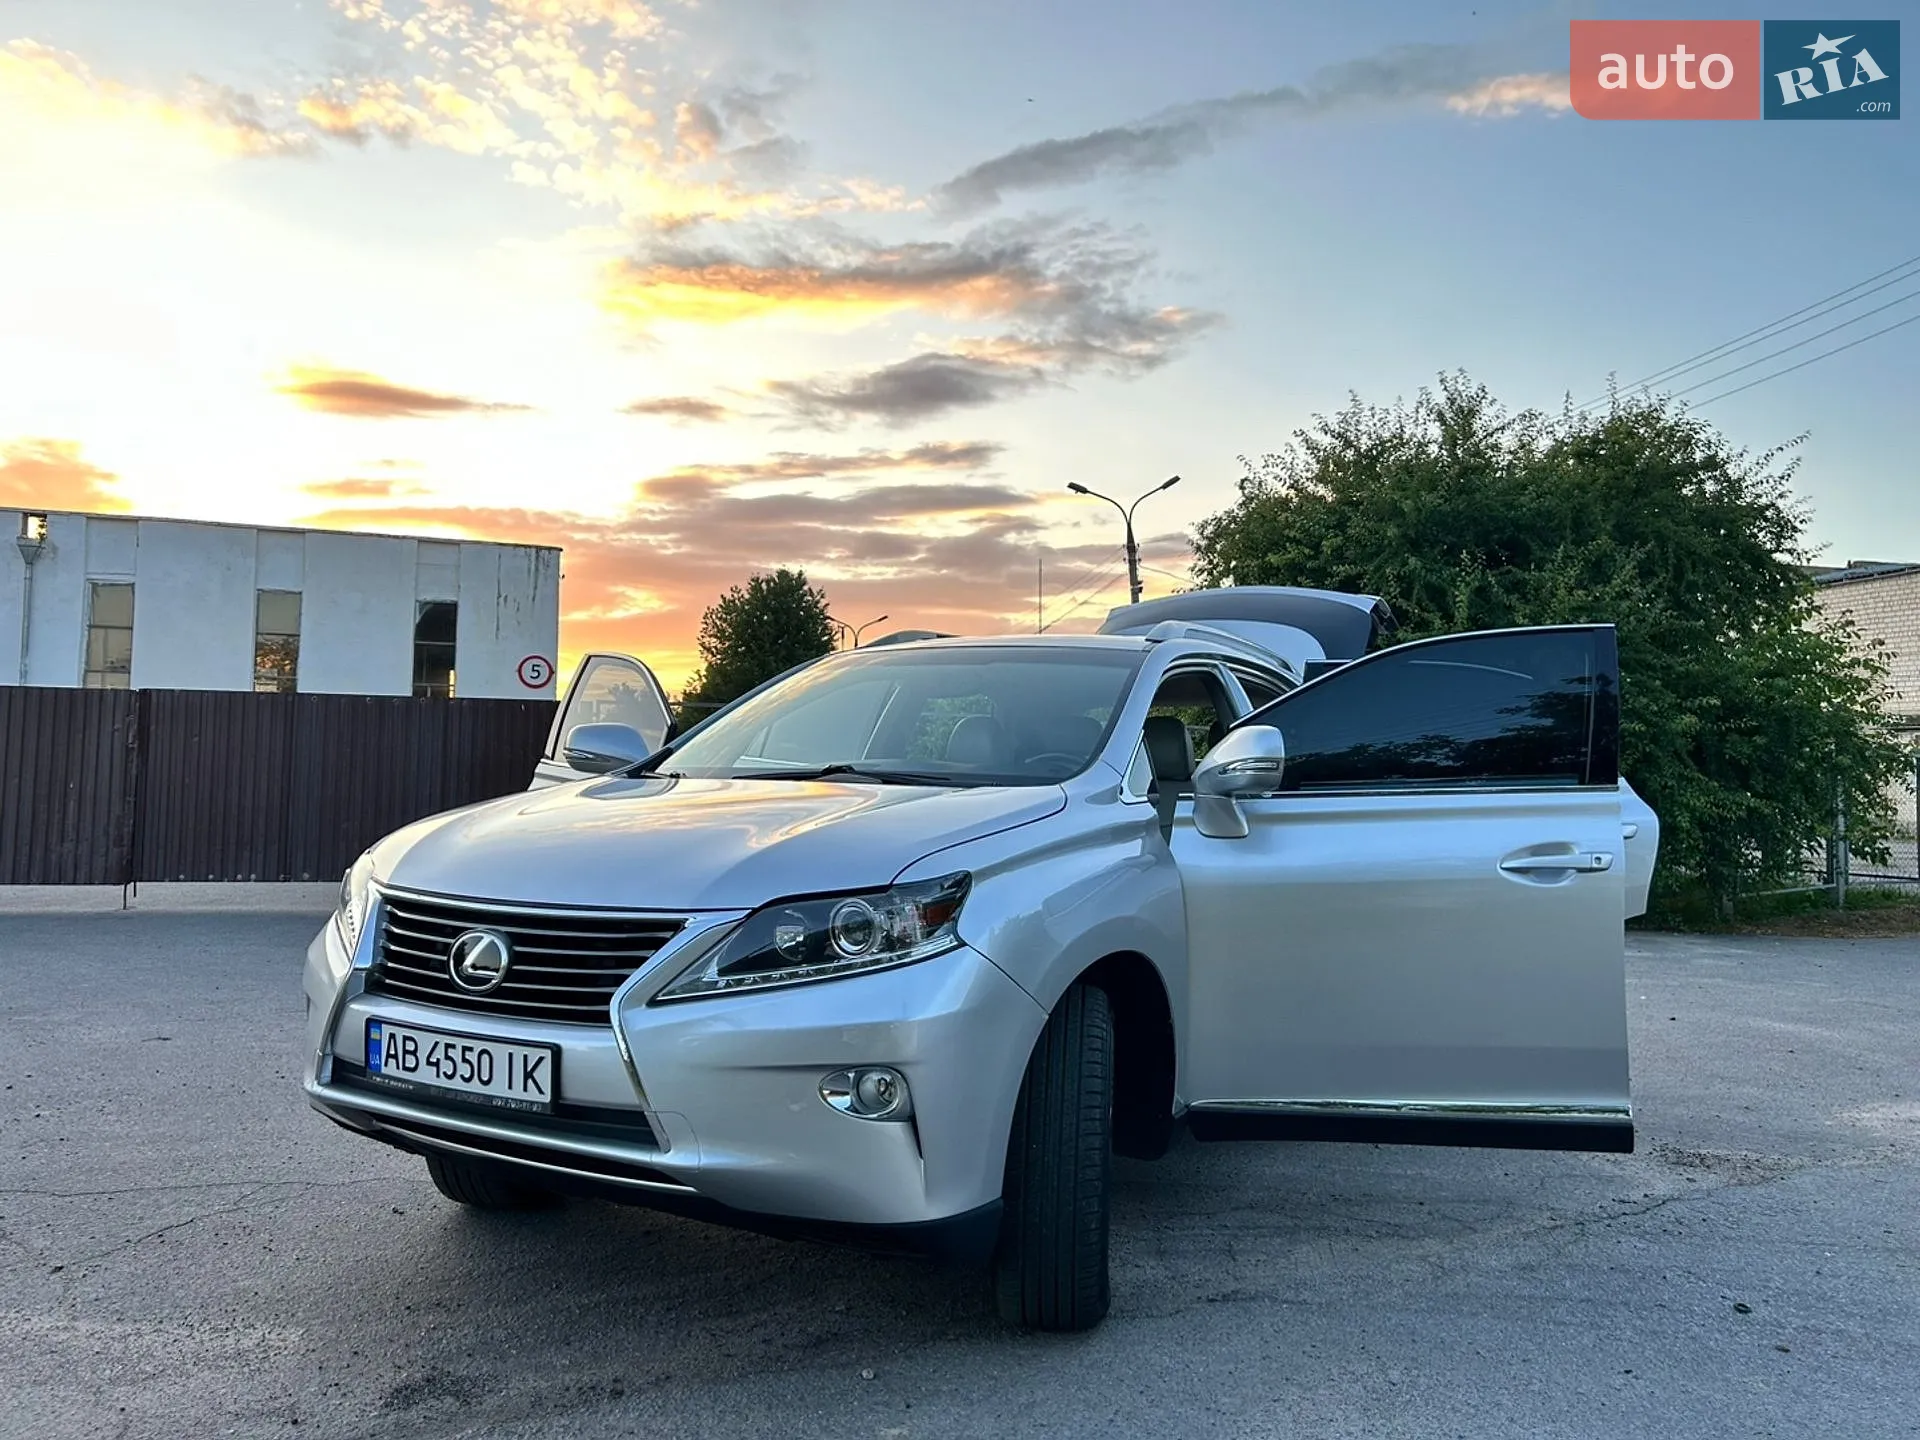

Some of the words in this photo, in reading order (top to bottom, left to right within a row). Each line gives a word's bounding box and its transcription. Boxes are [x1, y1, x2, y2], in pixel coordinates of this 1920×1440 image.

[530, 664, 541, 679] 5
[369, 1053, 380, 1065] UA
[384, 1032, 420, 1073] AB
[425, 1041, 493, 1086] 4550
[508, 1051, 546, 1096] IK
